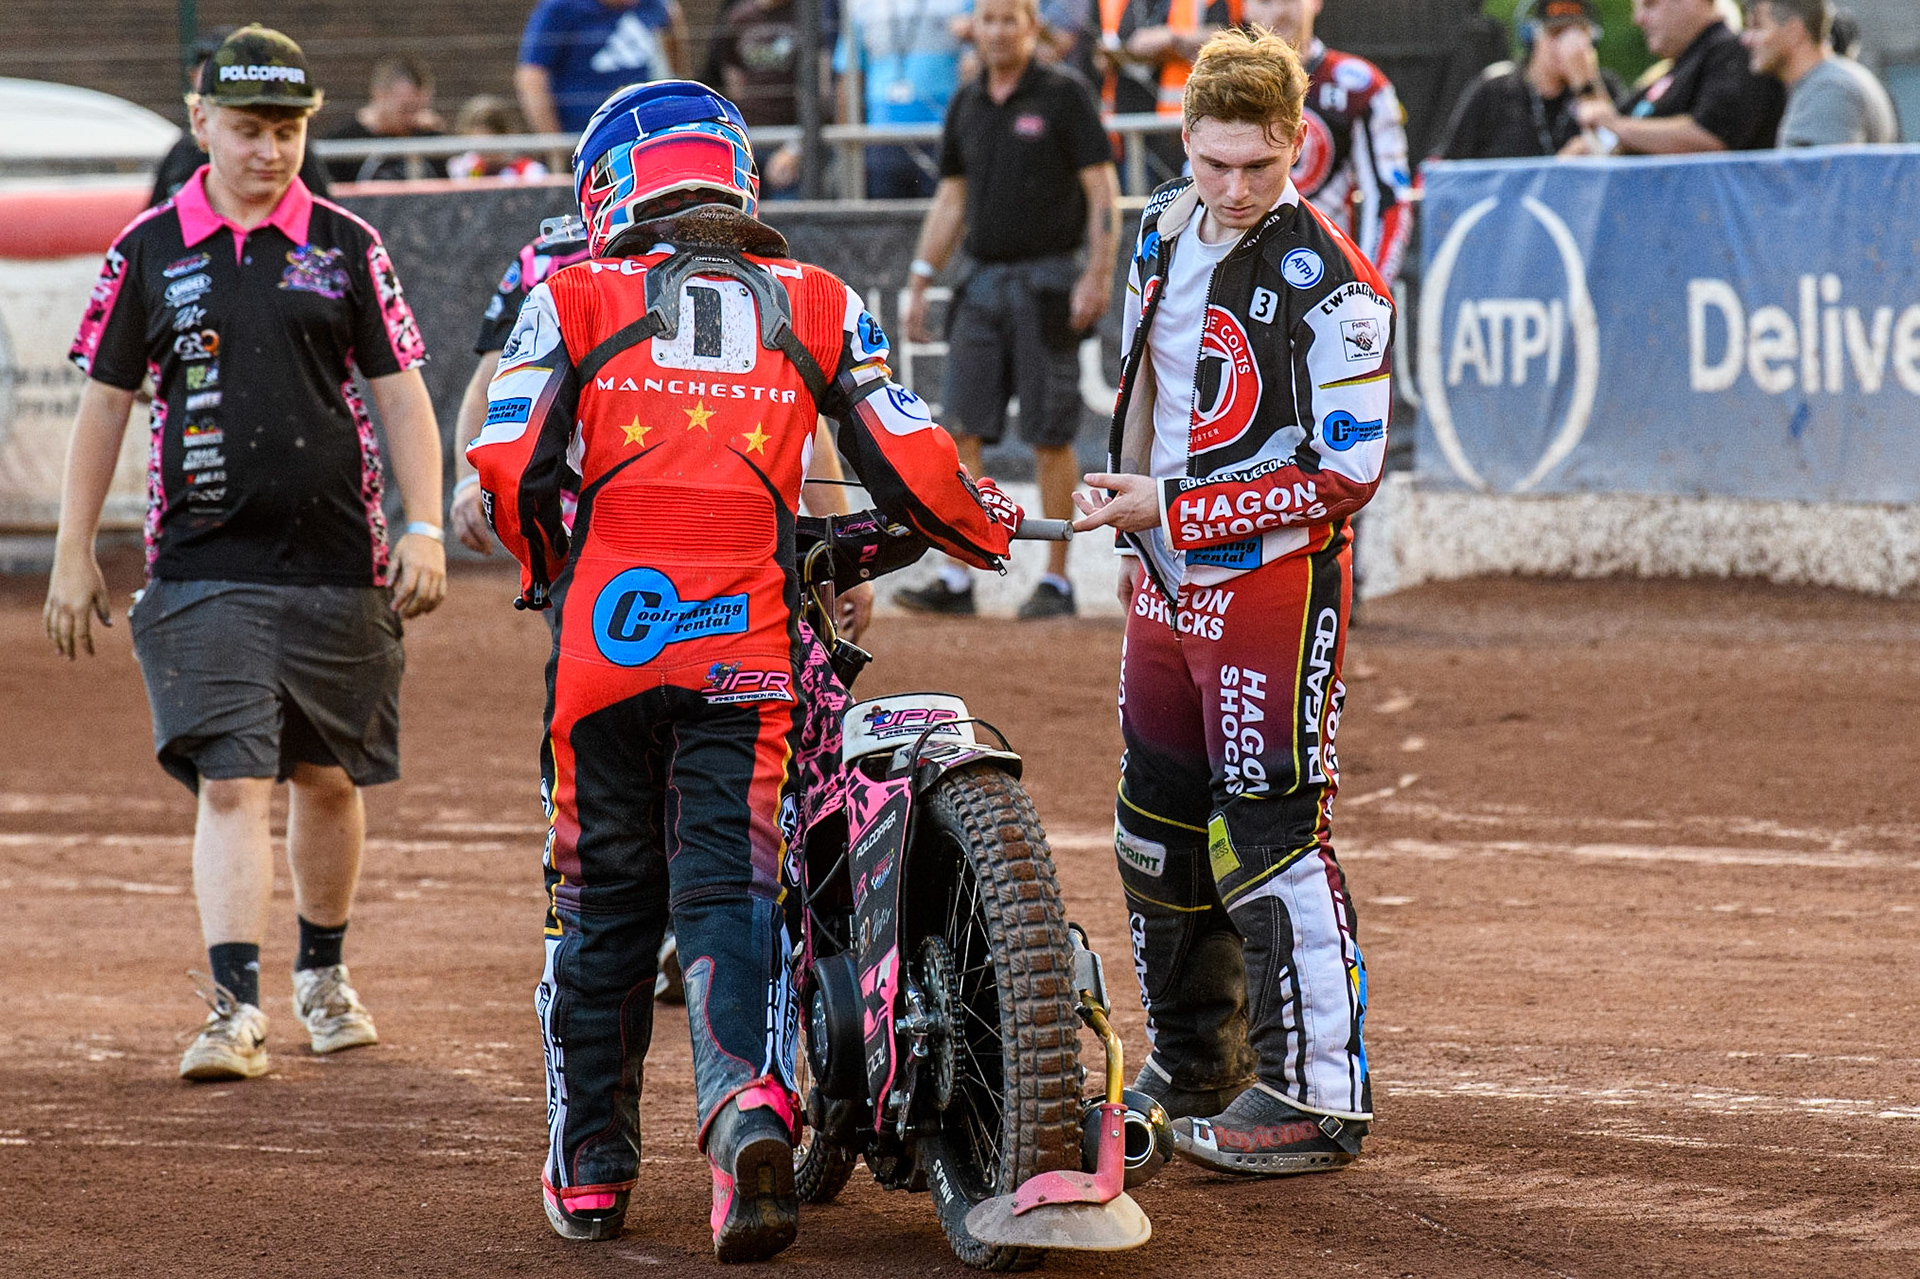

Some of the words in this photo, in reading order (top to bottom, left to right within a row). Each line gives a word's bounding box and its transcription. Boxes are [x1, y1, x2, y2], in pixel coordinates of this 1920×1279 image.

[220, 65, 305, 84] POLCOPPER
[1142, 201, 1172, 219] SHOC
[1290, 256, 1315, 280] ATPI
[686, 286, 722, 358] 1
[1255, 292, 1271, 318] 3
[1220, 324, 1251, 375] COLTS
[1448, 298, 1565, 387] ATPI
[596, 376, 797, 404] MANCHESTER
[1179, 480, 1318, 522] HAGON
[1181, 501, 1328, 542] SHOCKS
[1193, 552, 1246, 563] rental
[607, 590, 744, 642] Coolrunning
[674, 614, 731, 634] rental
[701, 671, 790, 693] JPR
[1305, 606, 1338, 785] DUGARD
[872, 708, 958, 730] JPR
[1220, 664, 1245, 796] SHOCKS
[1241, 666, 1271, 794] HAGON
[856, 809, 897, 862] POLCOPPER
[932, 1158, 955, 1205] ANLAS
